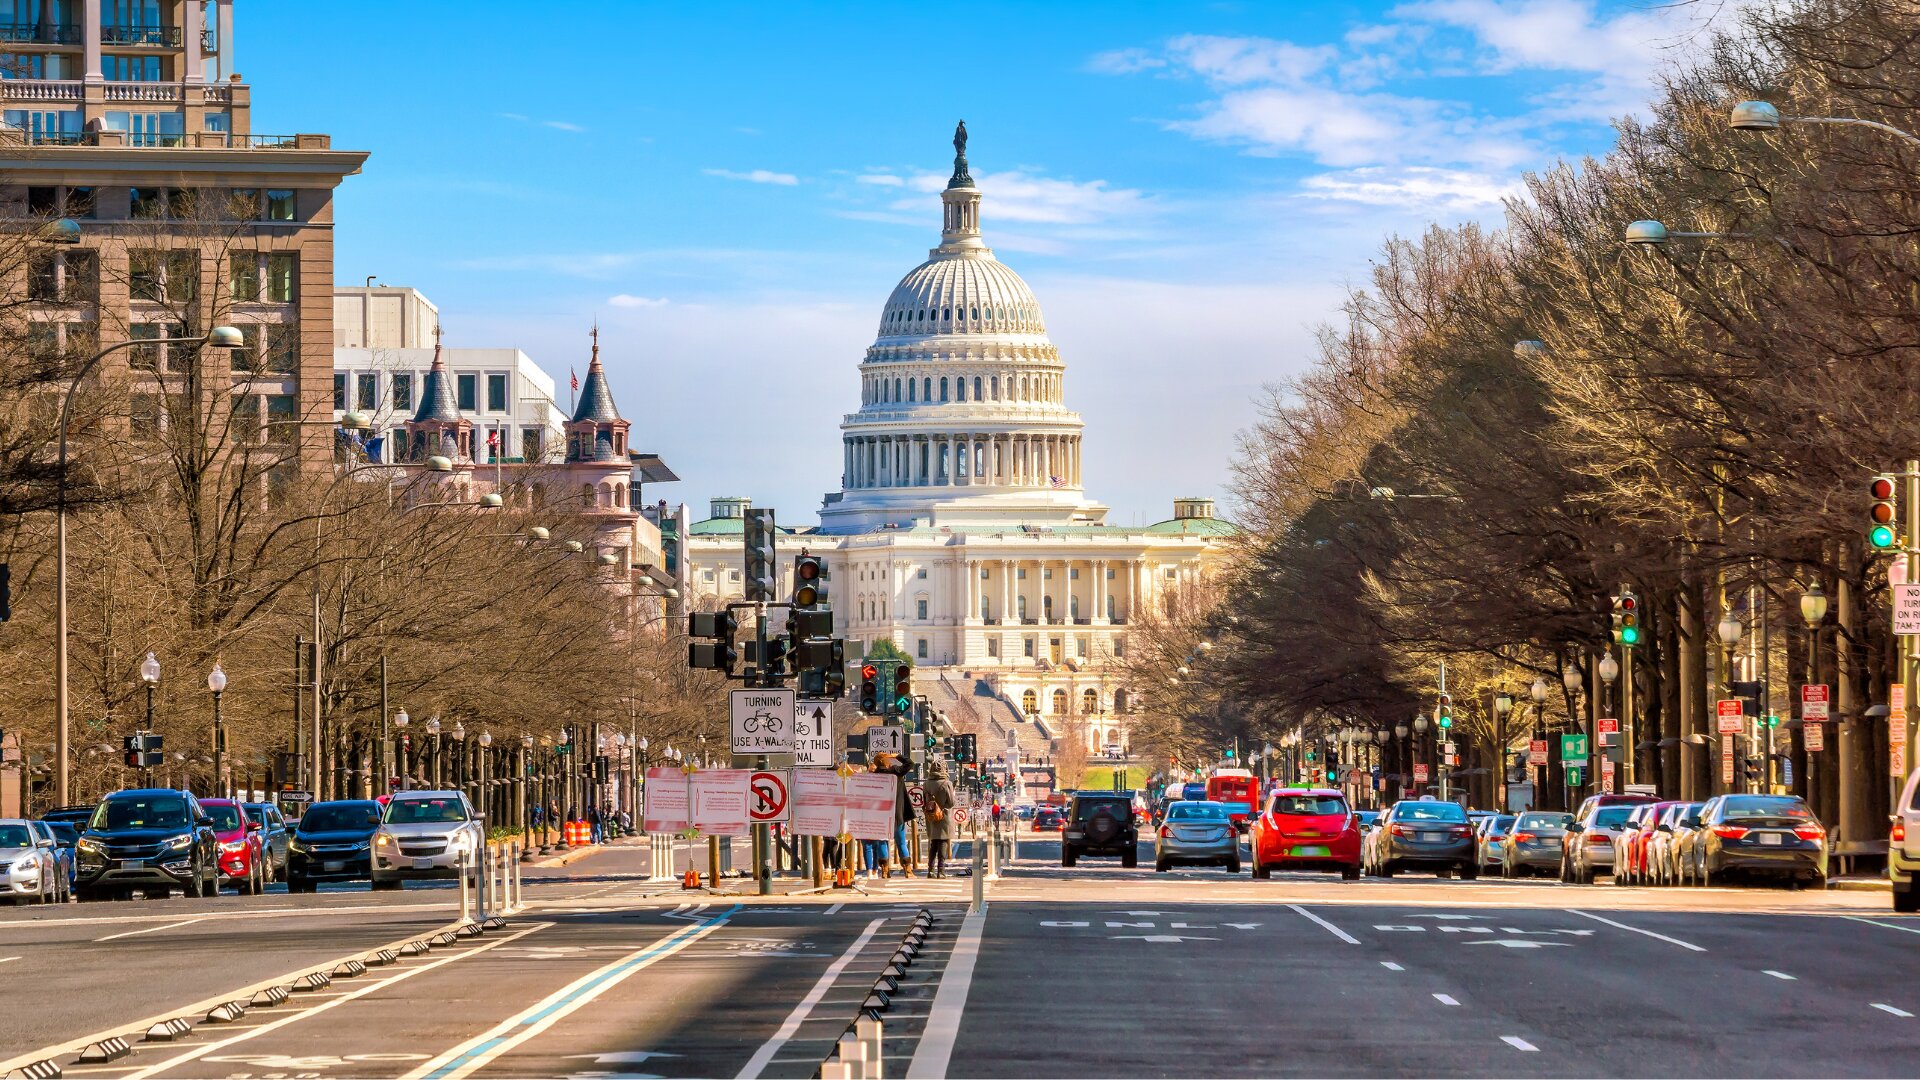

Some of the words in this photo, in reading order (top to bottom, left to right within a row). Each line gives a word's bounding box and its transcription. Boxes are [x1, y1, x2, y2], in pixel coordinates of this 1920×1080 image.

[1904, 600, 1920, 608] TUR
[744, 697, 782, 707] TURNING
[796, 705, 807, 716] RU
[734, 737, 751, 747] USE
[810, 739, 831, 750] THIS
[797, 752, 815, 763] NAL
[1039, 921, 1265, 930] ONLY
[1372, 924, 1597, 936] ONLY
